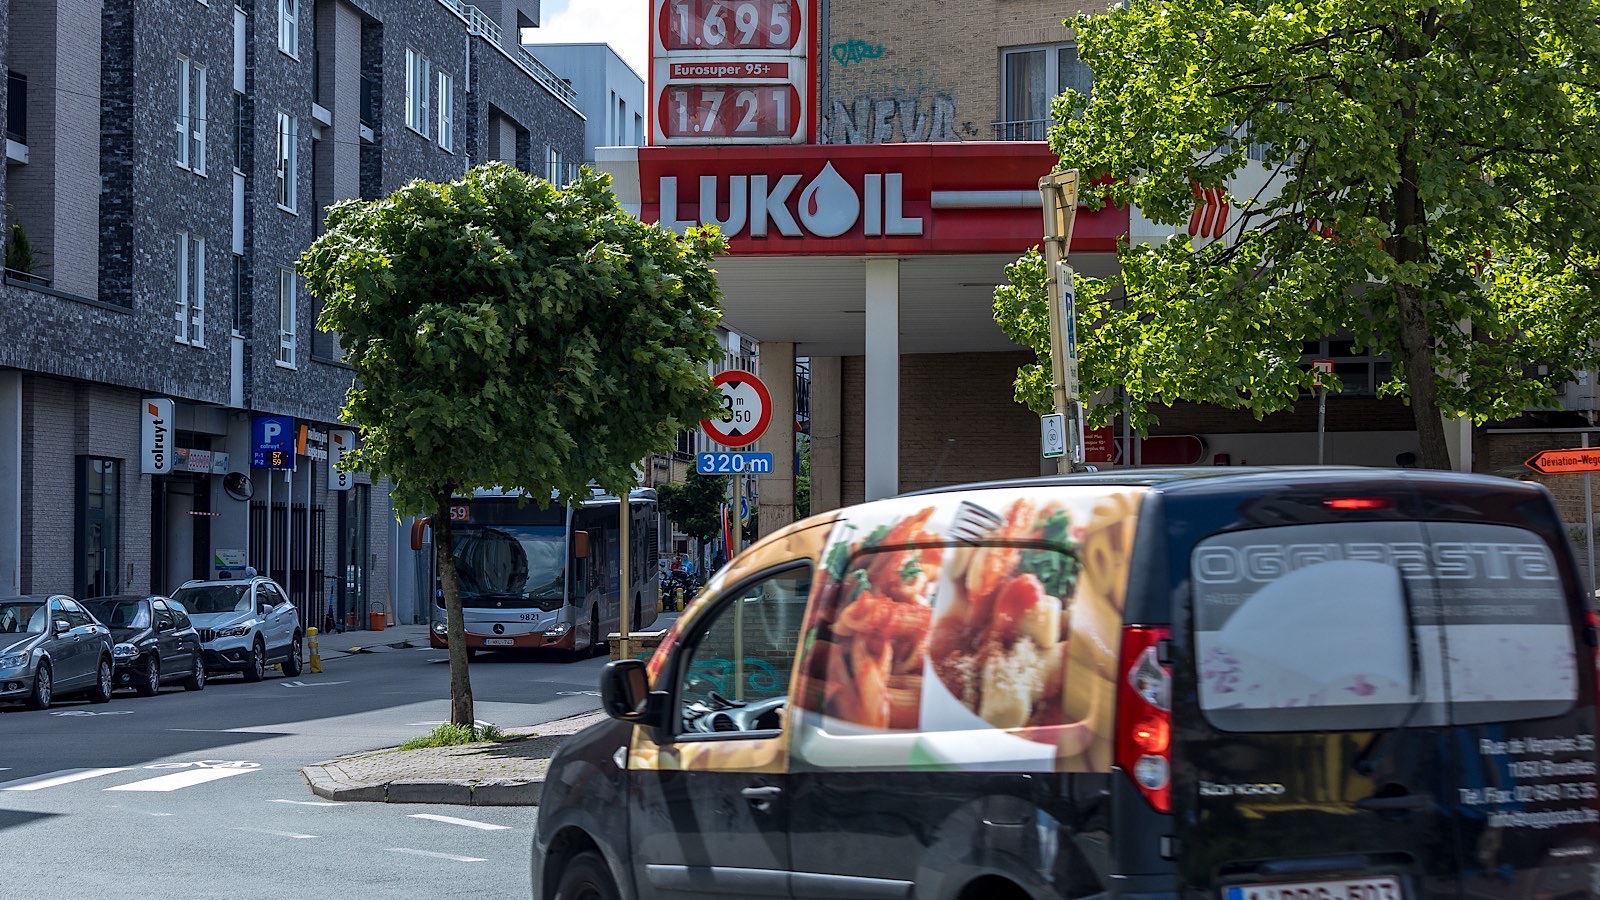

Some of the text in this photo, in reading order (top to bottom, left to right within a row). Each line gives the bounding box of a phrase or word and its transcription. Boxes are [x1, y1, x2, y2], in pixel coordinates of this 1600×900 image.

[676, 2, 791, 46] 1.695
[674, 63, 771, 79] Eurosuper 95+
[675, 90, 786, 133] 1.721
[659, 161, 923, 238] LUKOIL
[736, 397, 744, 406] m
[735, 410, 751, 423] 50
[264, 423, 281, 443] P
[151, 419, 168, 470] colruyt
[272, 451, 282, 459] 57
[272, 458, 282, 466] 59
[702, 453, 769, 472] 320 m
[1106, 453, 1113, 461] 2
[336, 446, 347, 487] colut
[450, 506, 467, 520] 59
[519, 613, 540, 621] 9821
